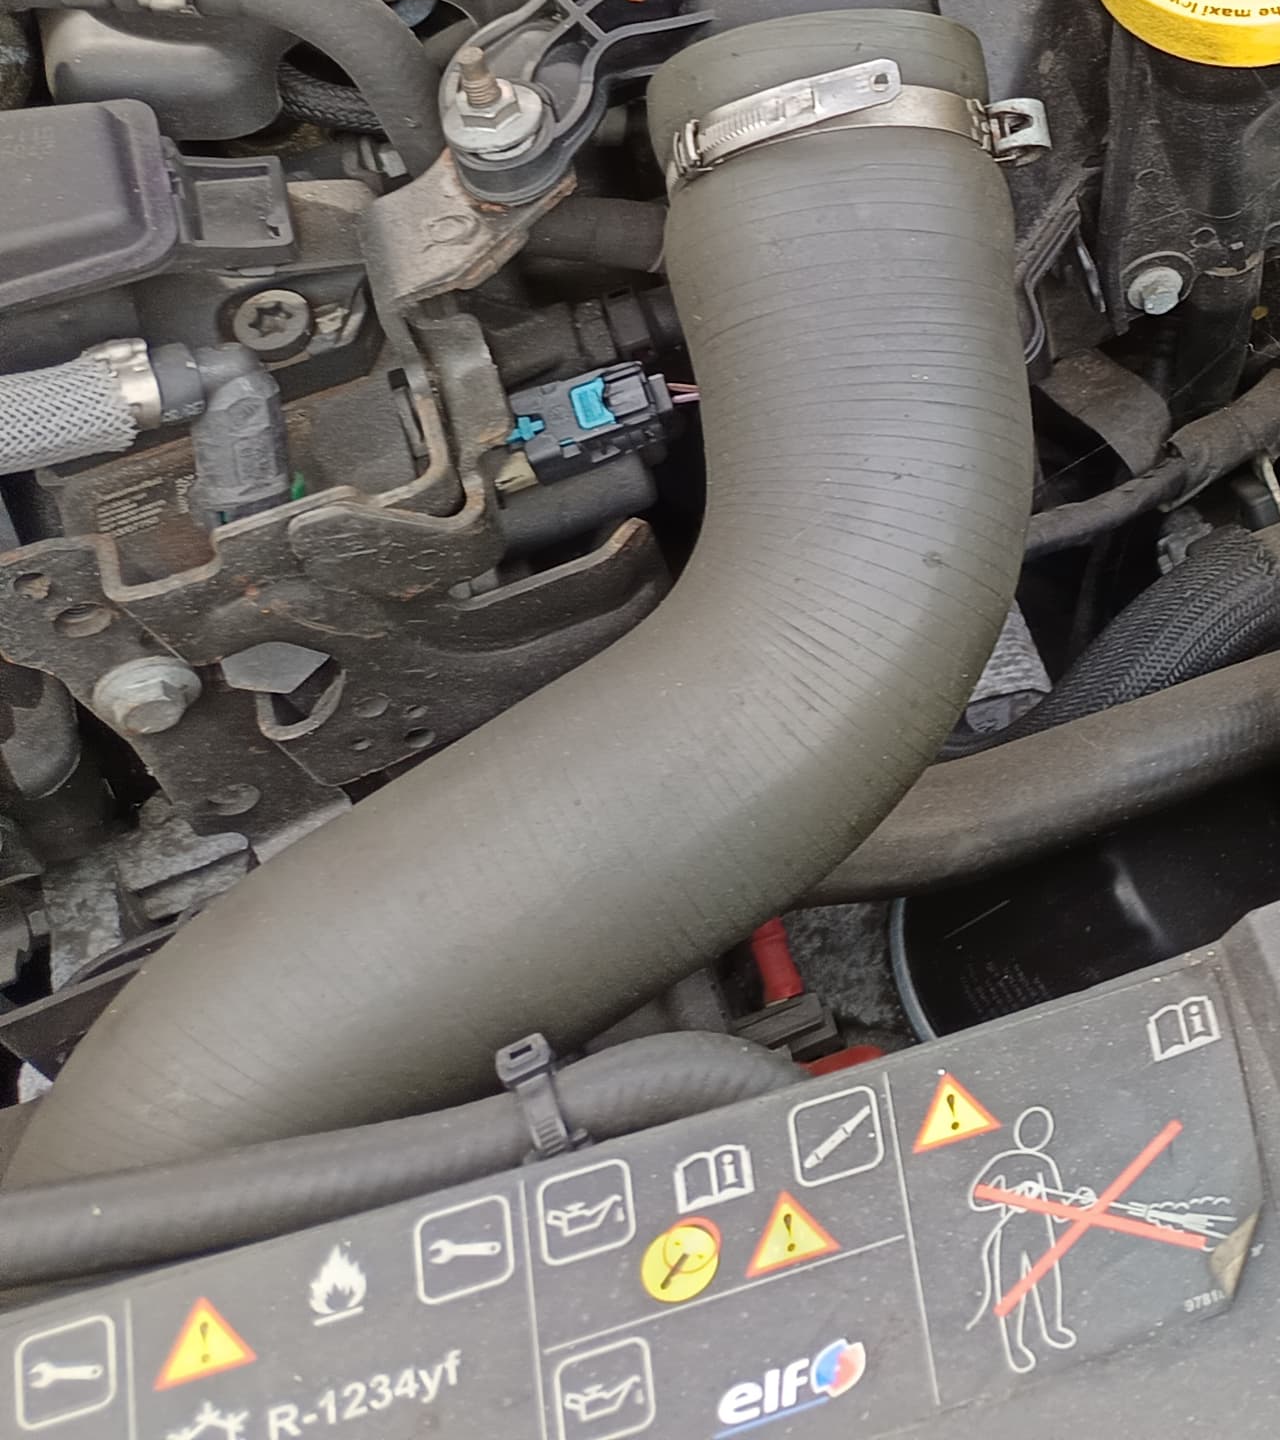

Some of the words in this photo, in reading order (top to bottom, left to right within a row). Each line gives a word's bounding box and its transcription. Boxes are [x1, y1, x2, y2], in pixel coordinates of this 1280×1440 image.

[1201, 5, 1251, 17] maxi
[267, 1349, 462, 1440] R-1234yf
[717, 1358, 810, 1425] elf
